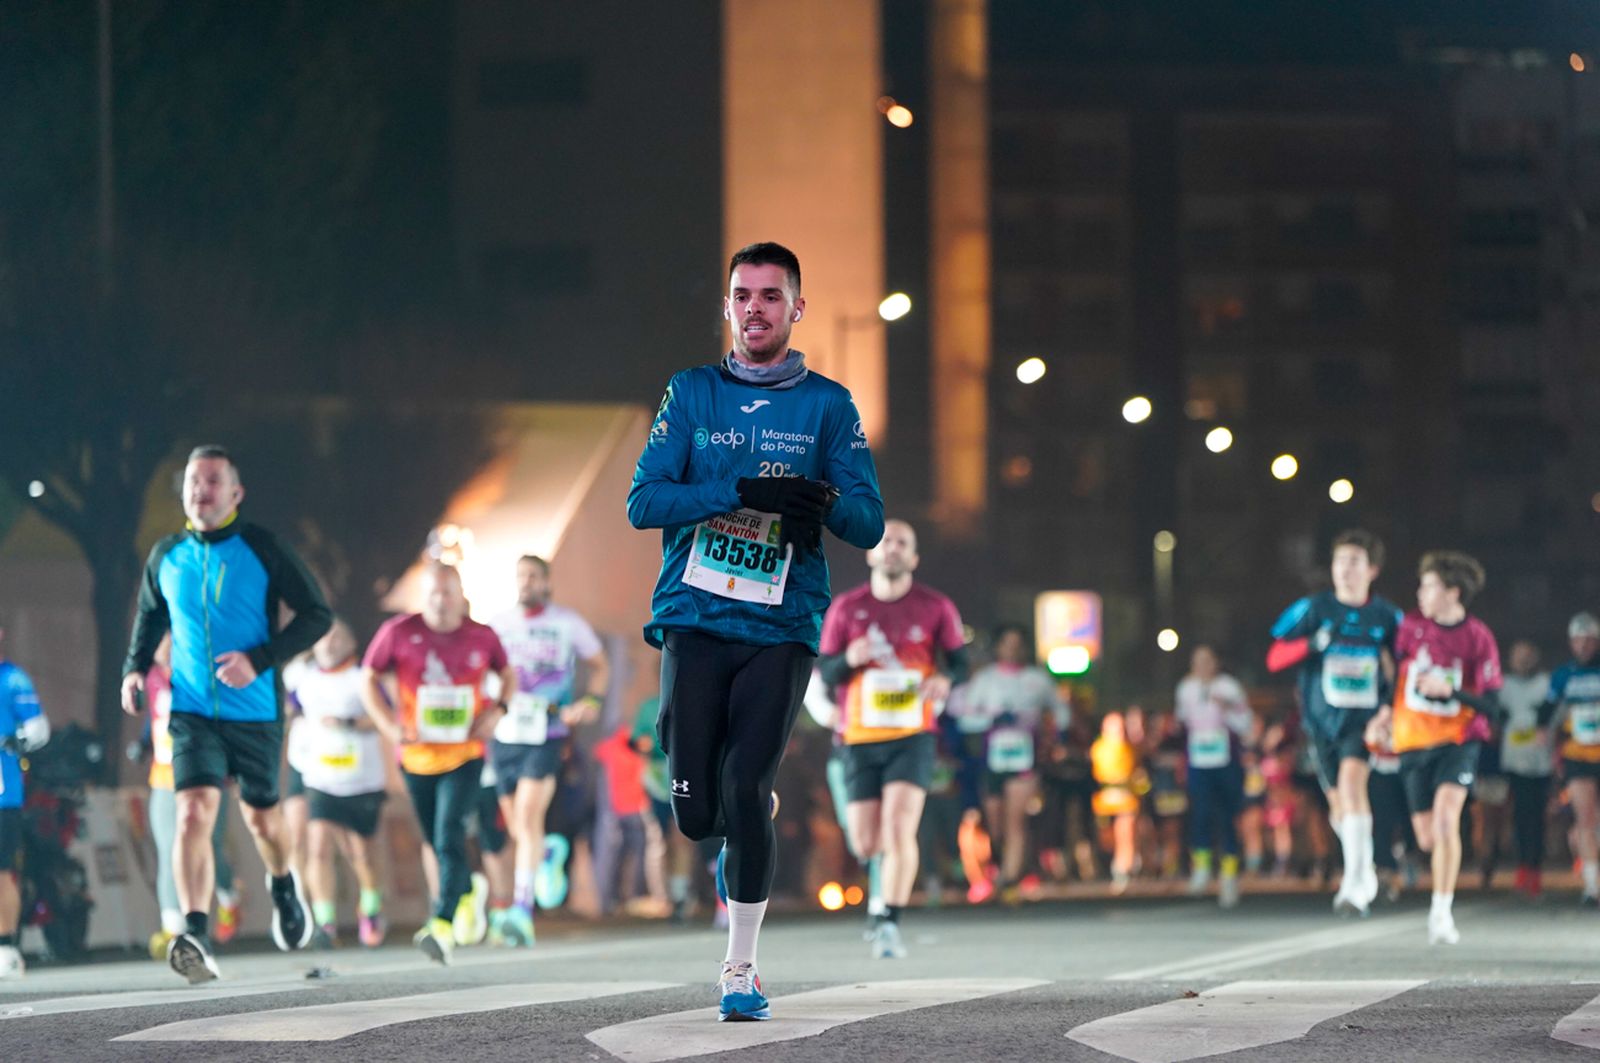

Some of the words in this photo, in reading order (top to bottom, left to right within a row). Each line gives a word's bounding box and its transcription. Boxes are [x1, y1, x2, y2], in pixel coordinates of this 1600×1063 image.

[711, 427, 745, 449] edp
[761, 428, 815, 444] Maratona
[760, 441, 775, 452] do
[777, 442, 806, 455] Porto
[851, 441, 870, 450] HYU
[707, 519, 726, 533] SAN
[726, 525, 760, 541] ANTÓN
[719, 513, 749, 527] NOCHE
[750, 520, 762, 530] DE
[703, 531, 778, 574] 13538
